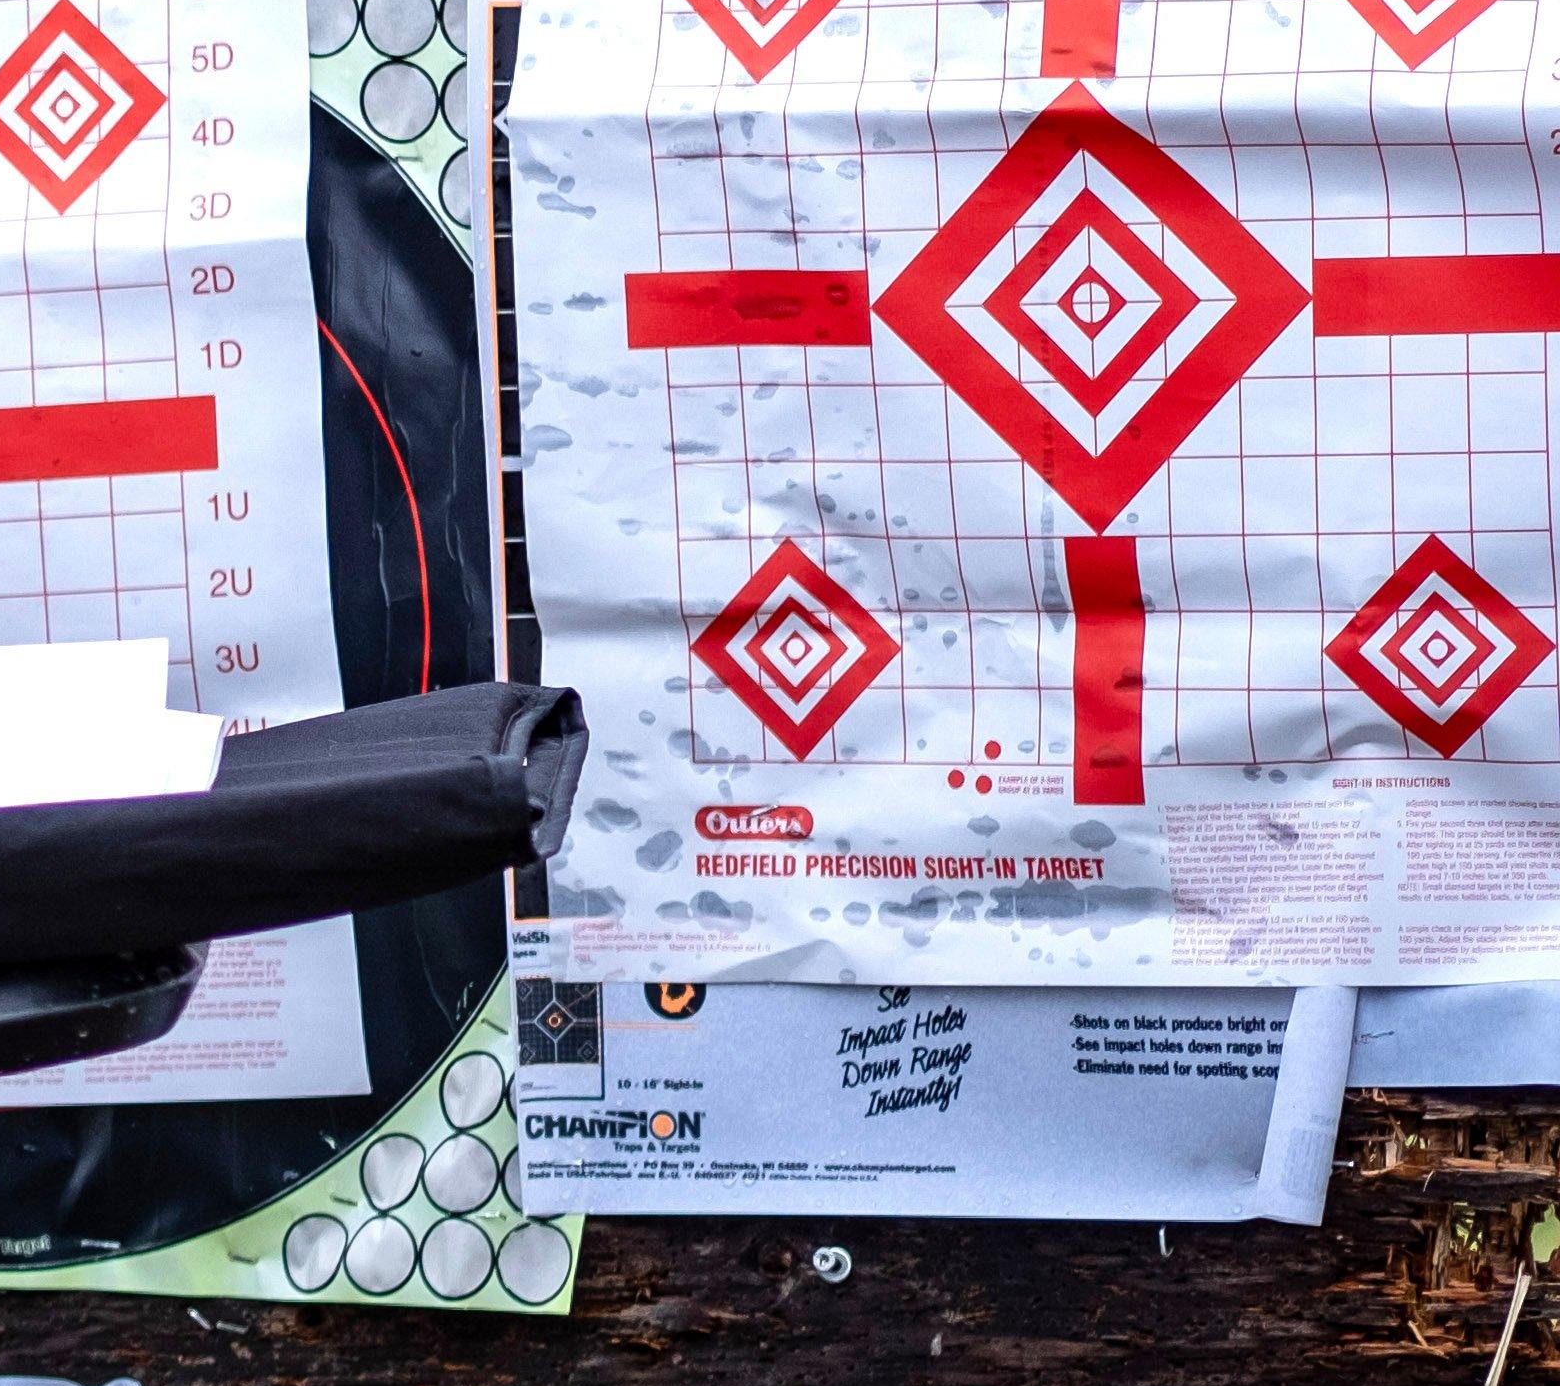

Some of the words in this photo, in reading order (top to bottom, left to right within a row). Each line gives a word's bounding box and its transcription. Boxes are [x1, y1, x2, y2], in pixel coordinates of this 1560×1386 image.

[192, 43, 233, 72] 5D
[193, 119, 234, 146] 4D
[190, 193, 231, 221] 3D
[192, 266, 234, 294] 2D
[201, 340, 241, 369] 1D
[209, 492, 248, 520] 1U
[211, 567, 252, 597] 2U
[216, 643, 258, 673] 3U
[1376, 777, 1451, 789] INSTRUCTIONS
[696, 855, 796, 877] REDFIELD
[806, 856, 917, 878] PRECISION
[925, 857, 1016, 878] SIGHT-IN
[1024, 857, 1104, 879] TARGET
[878, 986, 912, 1012] See
[836, 1018, 909, 1060] Impact
[912, 1004, 968, 1040] Holes
[1114, 1018, 1130, 1030] on
[1134, 1015, 1167, 1030] black
[1172, 1016, 1223, 1033] produce
[1228, 1016, 1266, 1034] bright
[1104, 1038, 1146, 1054] impact
[1150, 1038, 1184, 1053] holes
[1188, 1039, 1222, 1054] down
[1226, 1041, 1263, 1057] range
[841, 1057, 902, 1089] Down
[910, 1041, 972, 1076] Range
[1138, 1061, 1169, 1075] need
[1173, 1061, 1192, 1076] for
[1196, 1062, 1248, 1079] spotting
[864, 1074, 963, 1118] Instantly!
[525, 1111, 702, 1140] CHAMPION
[614, 1141, 643, 1152] Traps
[646, 1141, 657, 1153] &
[660, 1141, 701, 1154] Targets
